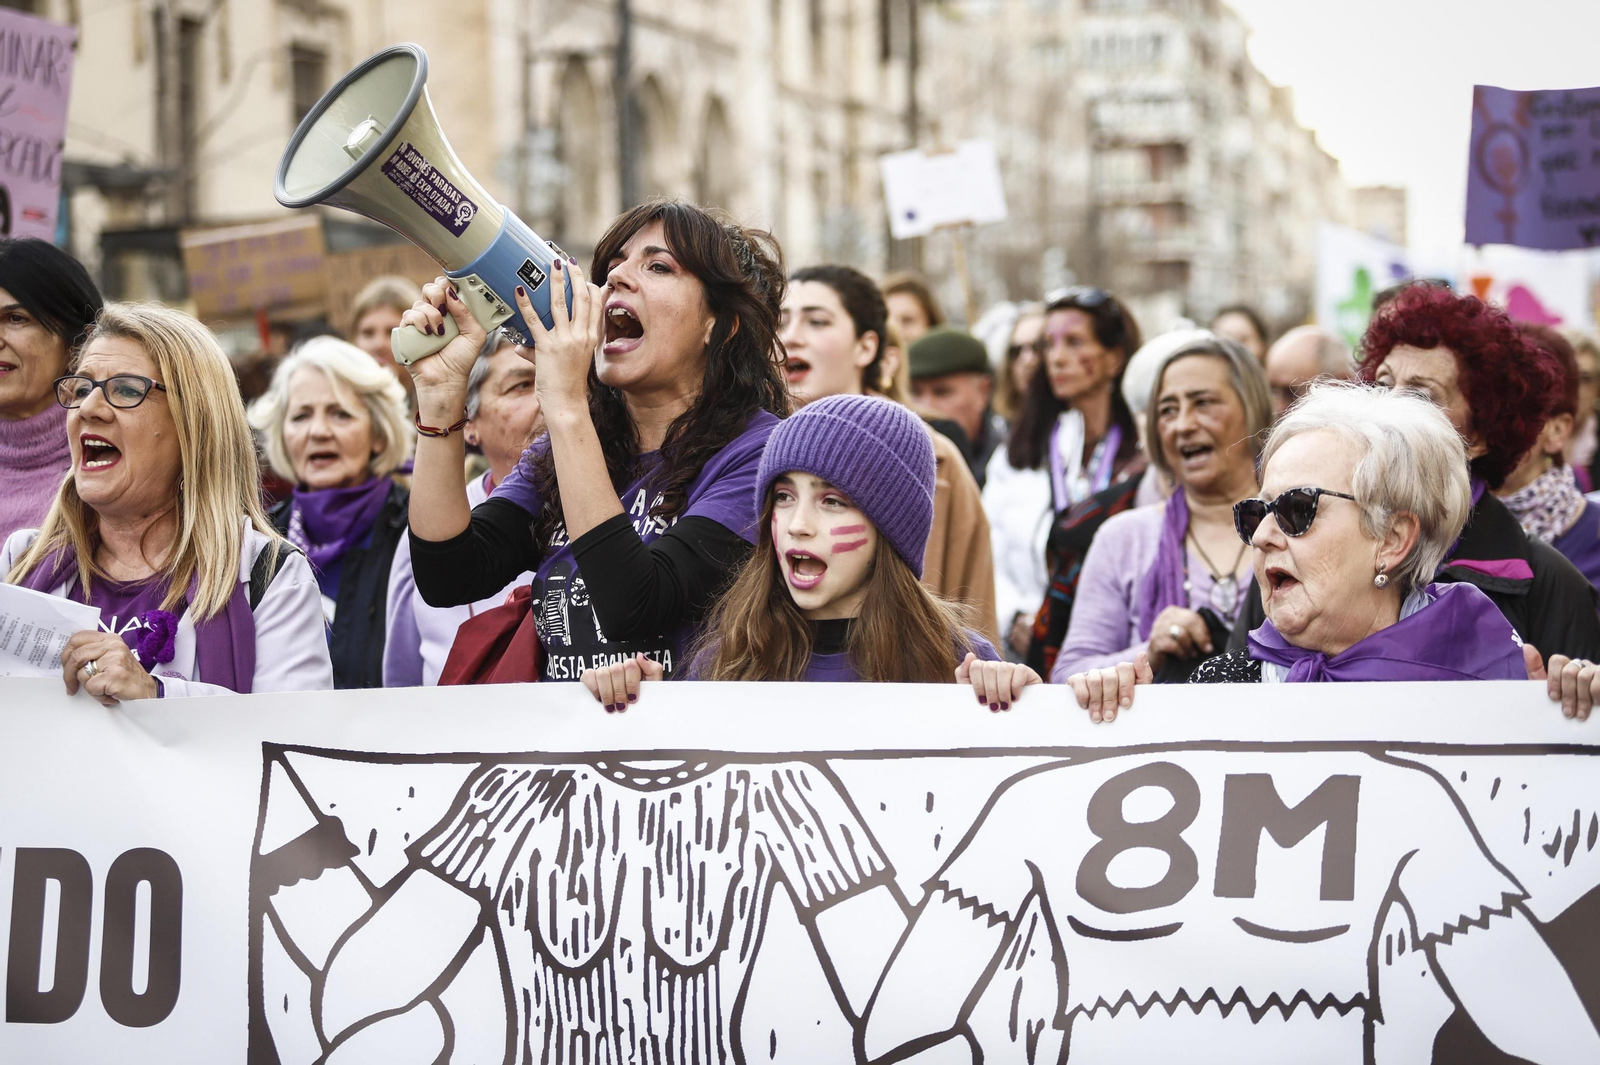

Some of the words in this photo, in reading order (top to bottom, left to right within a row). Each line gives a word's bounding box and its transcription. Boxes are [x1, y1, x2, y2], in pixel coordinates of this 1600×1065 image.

[416, 179, 454, 215] EXPLOTADAS
[429, 172, 461, 203] PARADAS
[1075, 761, 1361, 914] 8M
[0, 846, 183, 1028] DO
